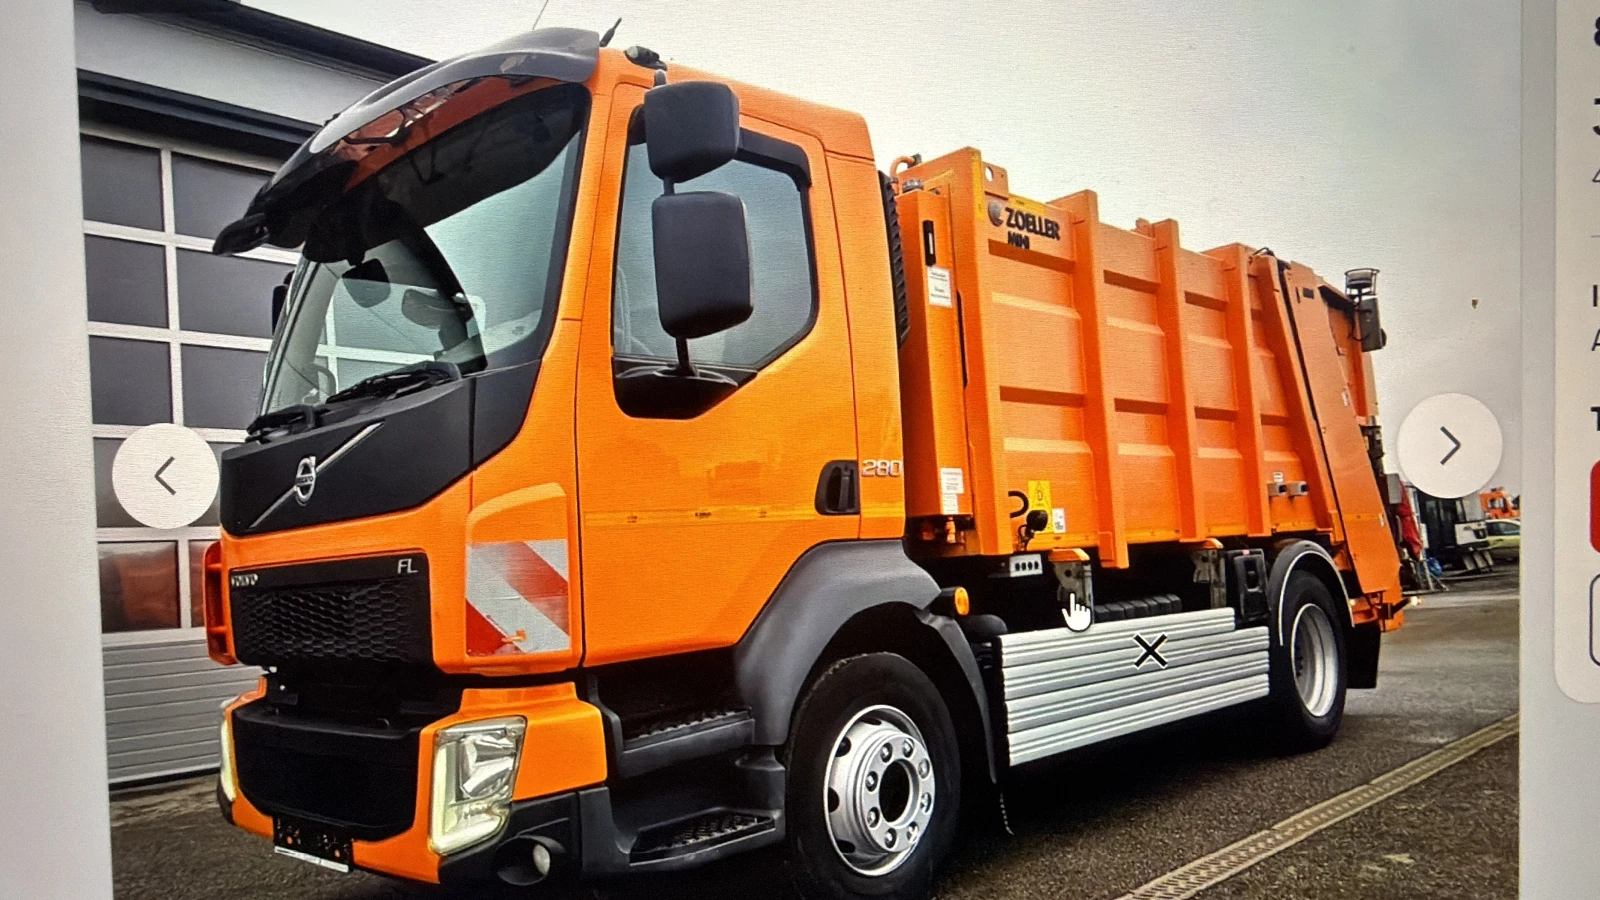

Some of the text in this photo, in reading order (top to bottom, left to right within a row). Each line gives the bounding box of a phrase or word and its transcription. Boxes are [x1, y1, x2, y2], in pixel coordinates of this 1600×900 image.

[1005, 206, 1061, 241] ZOELLER
[861, 459, 904, 477] 280
[397, 558, 420, 574] FL
